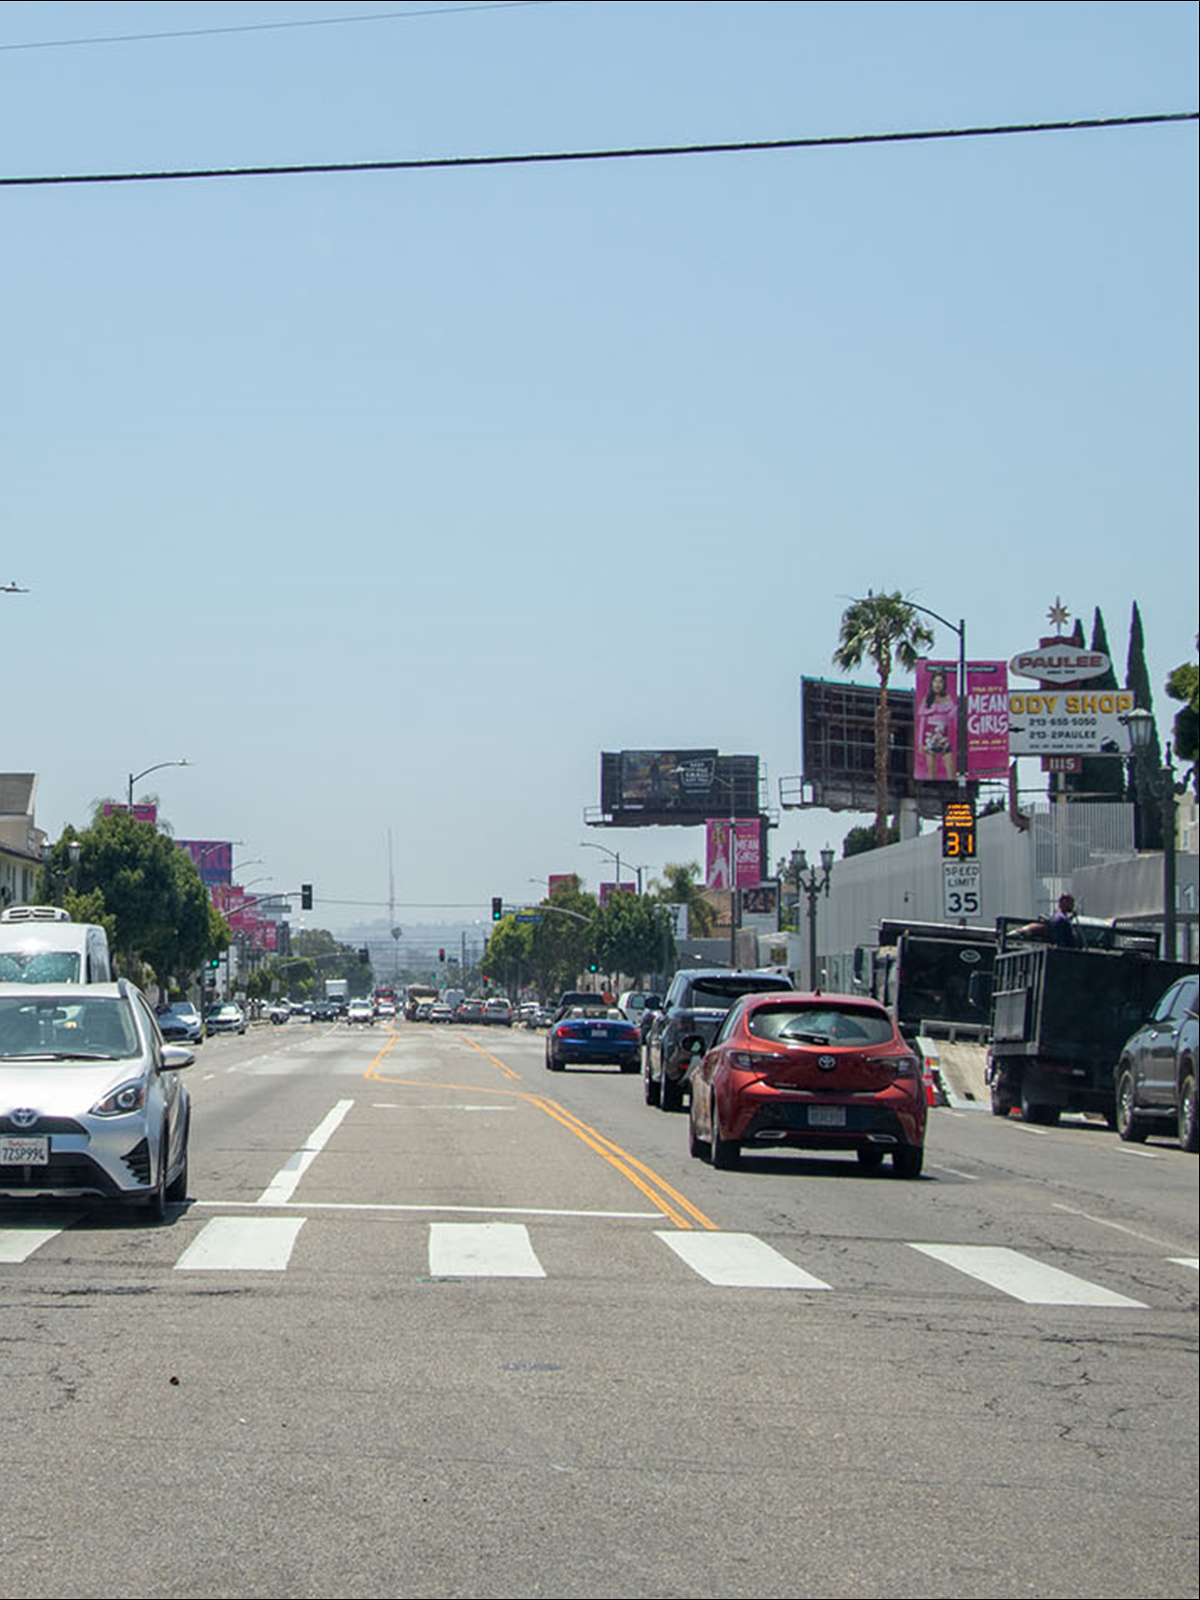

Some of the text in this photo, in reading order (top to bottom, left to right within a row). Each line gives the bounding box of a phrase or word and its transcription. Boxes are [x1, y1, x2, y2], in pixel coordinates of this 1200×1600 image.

[1018, 656, 1104, 669] PAULEE
[968, 694, 1007, 714] MEAN
[1010, 695, 1132, 714] ODY SHOP
[967, 714, 1009, 735] GIRLS
[1049, 758, 1075, 769] 1115
[947, 832, 974, 855] 31
[945, 867, 979, 876] SPEED
[948, 878, 976, 887] LIMIT
[948, 892, 978, 912] 35
